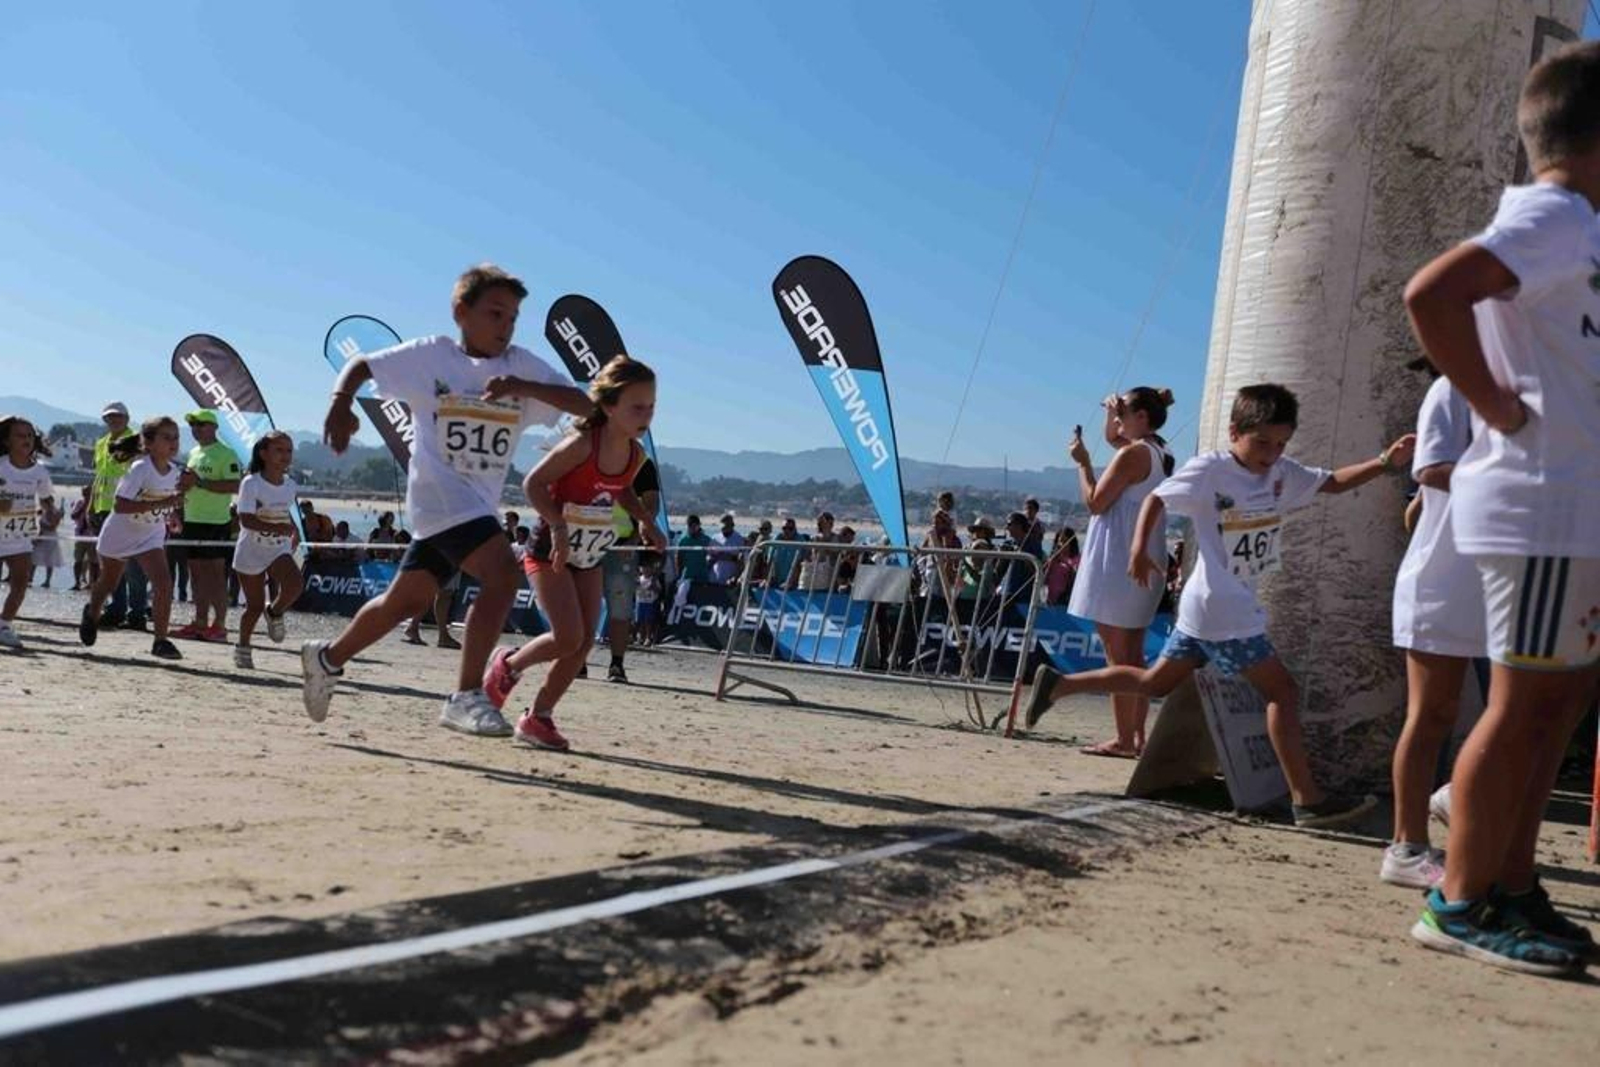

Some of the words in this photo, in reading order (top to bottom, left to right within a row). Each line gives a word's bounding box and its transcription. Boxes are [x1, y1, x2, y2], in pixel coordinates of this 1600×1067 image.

[446, 421, 511, 457] 516
[569, 528, 615, 552] 472
[668, 604, 848, 638] POWERADE
